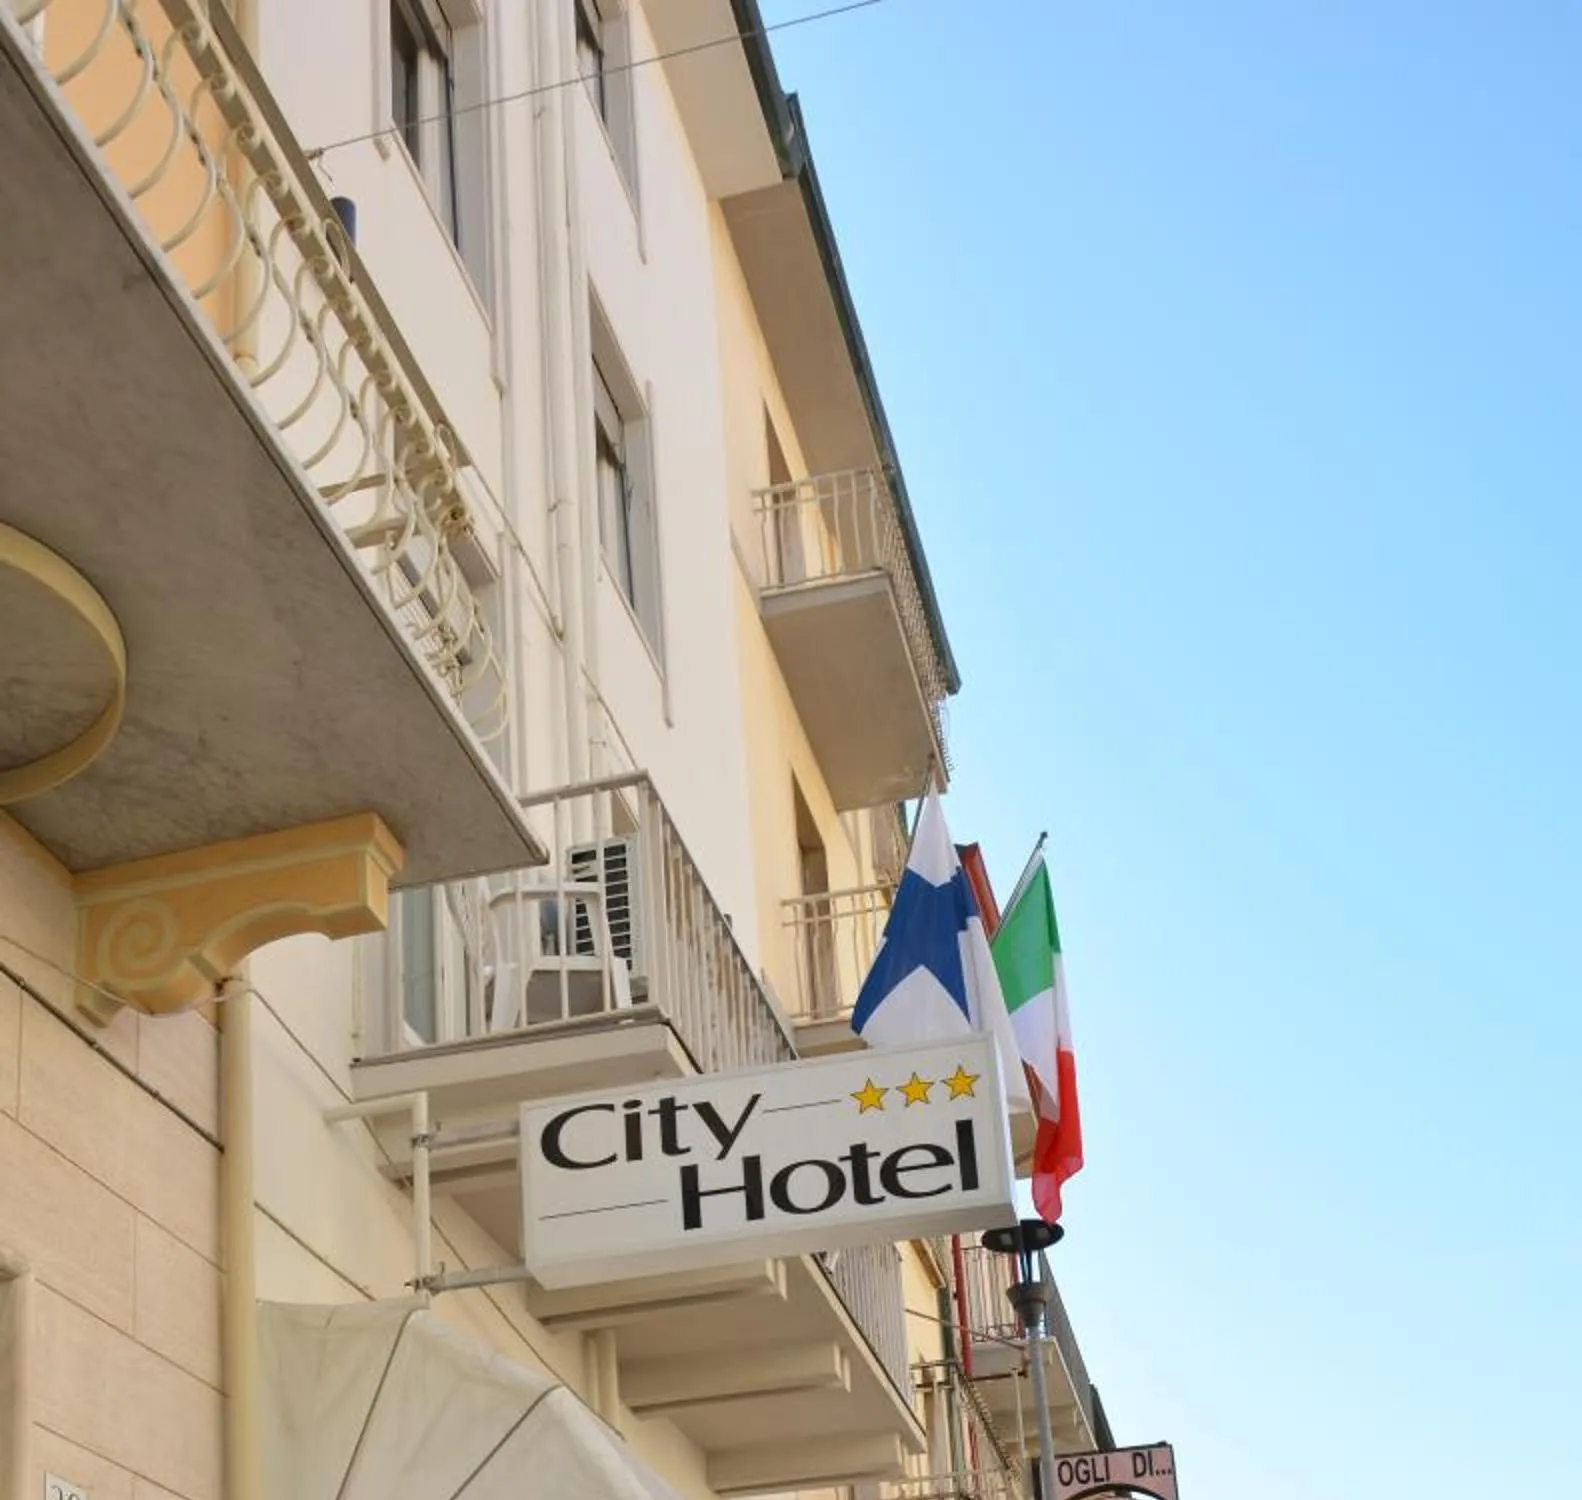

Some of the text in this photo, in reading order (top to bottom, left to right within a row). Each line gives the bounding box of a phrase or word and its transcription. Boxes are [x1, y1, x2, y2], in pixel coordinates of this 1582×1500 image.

[540, 1093, 762, 1170] City
[680, 1119, 979, 1231] Hotel
[1057, 1450, 1172, 1487] OGLI DI...
